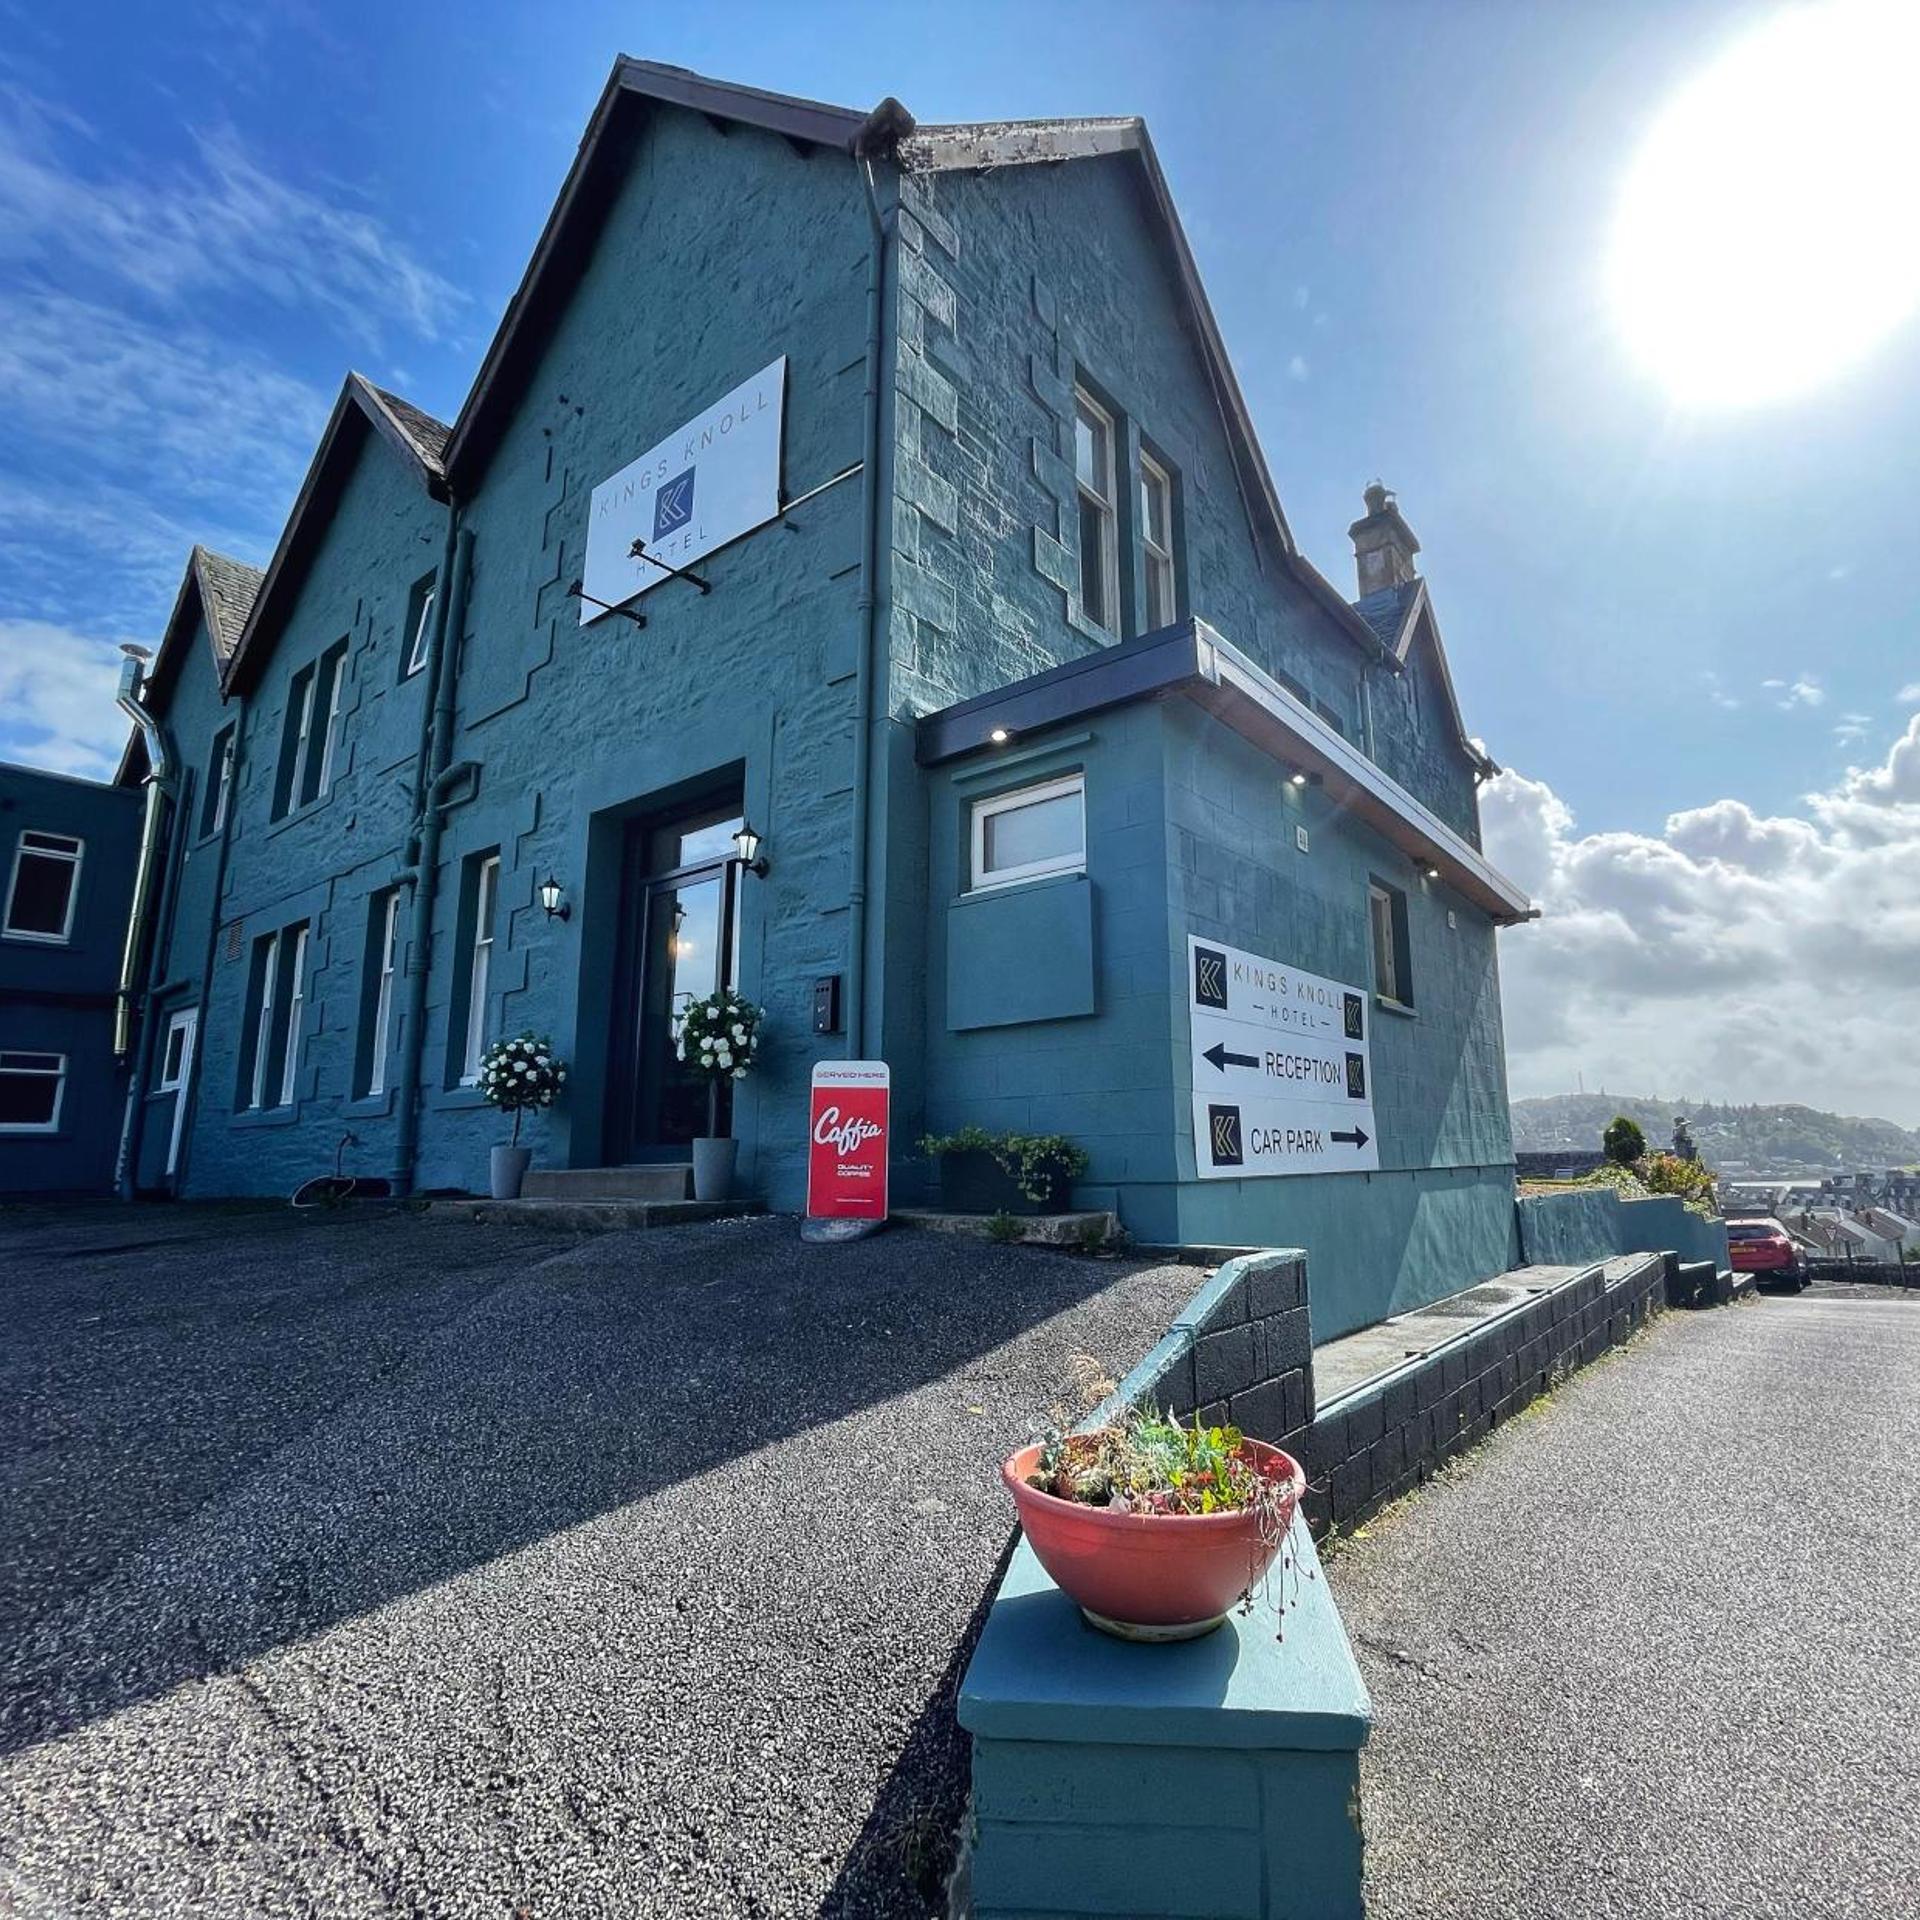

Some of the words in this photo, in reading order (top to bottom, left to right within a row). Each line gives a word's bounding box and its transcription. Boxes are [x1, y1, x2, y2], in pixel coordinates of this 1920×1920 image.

[599, 458, 669, 519] KINGS
[684, 390, 769, 461] KNOLL
[1233, 961, 1288, 995] KINGS
[1297, 983, 1343, 1011] KNOLL
[1271, 1005, 1316, 1028] HOTEL
[1265, 1051, 1341, 1085] RECEPTION
[813, 1106, 883, 1156] Caffia
[1250, 1127, 1282, 1155] CAR
[1286, 1129, 1324, 1154] PARK
